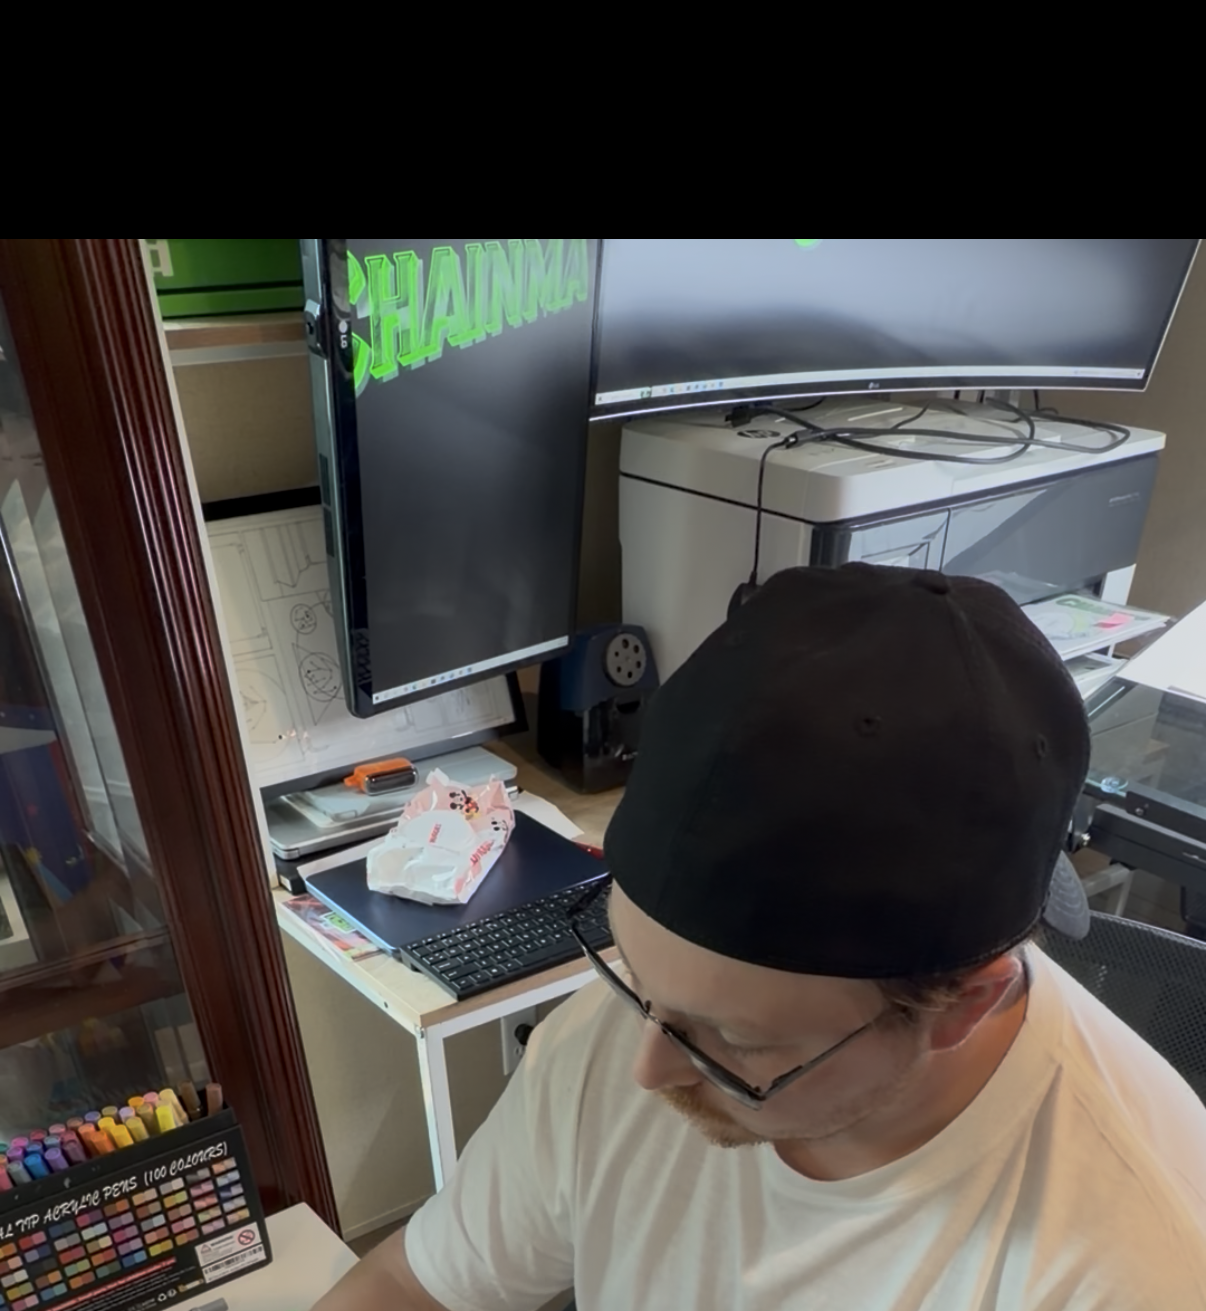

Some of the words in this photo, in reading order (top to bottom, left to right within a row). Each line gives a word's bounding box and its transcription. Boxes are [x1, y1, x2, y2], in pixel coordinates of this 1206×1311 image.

[0, 1223, 14, 1240] AL
[14, 1213, 40, 1233] TIP
[43, 1189, 102, 1225] ACRYLIC
[102, 1175, 138, 1200] PENS
[143, 1165, 168, 1187] (100
[168, 1141, 229, 1175] COLOURS)
